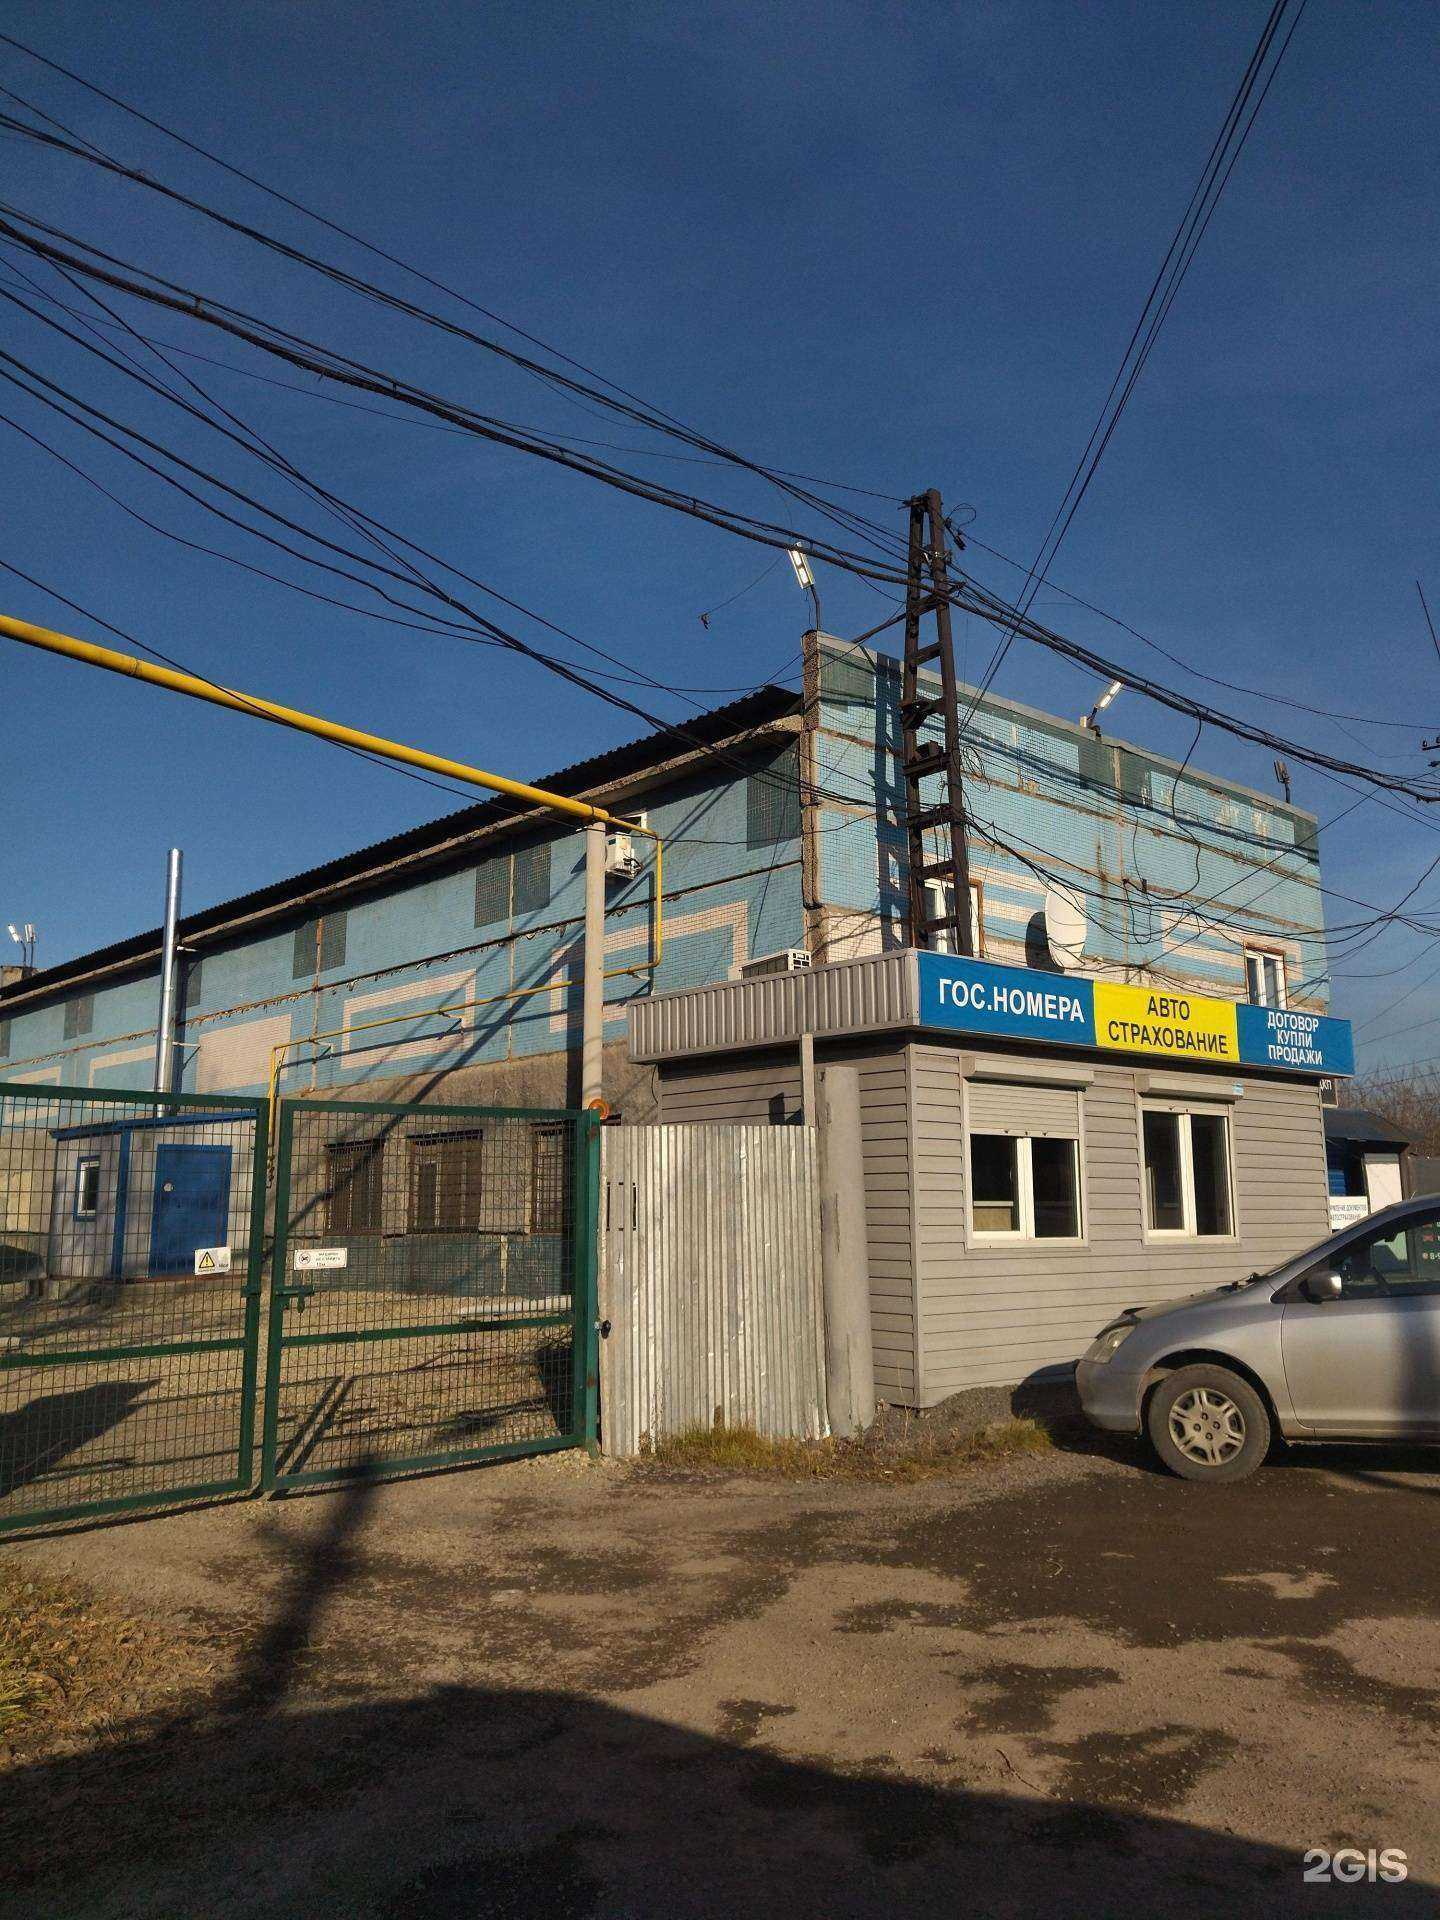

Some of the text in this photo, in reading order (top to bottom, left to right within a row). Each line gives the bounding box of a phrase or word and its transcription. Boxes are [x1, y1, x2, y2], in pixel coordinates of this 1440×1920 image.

[938, 978, 1085, 1023] ГОС.НОМЕРА
[1147, 996, 1190, 1021] АВТО
[1267, 1011, 1319, 1033] ДОГОВОР
[1108, 1021, 1228, 1054] СТРАХОВАНИЕ
[1277, 1029, 1313, 1049] КУПЛИ
[1268, 1045, 1323, 1065] ПРОДАЖИ
